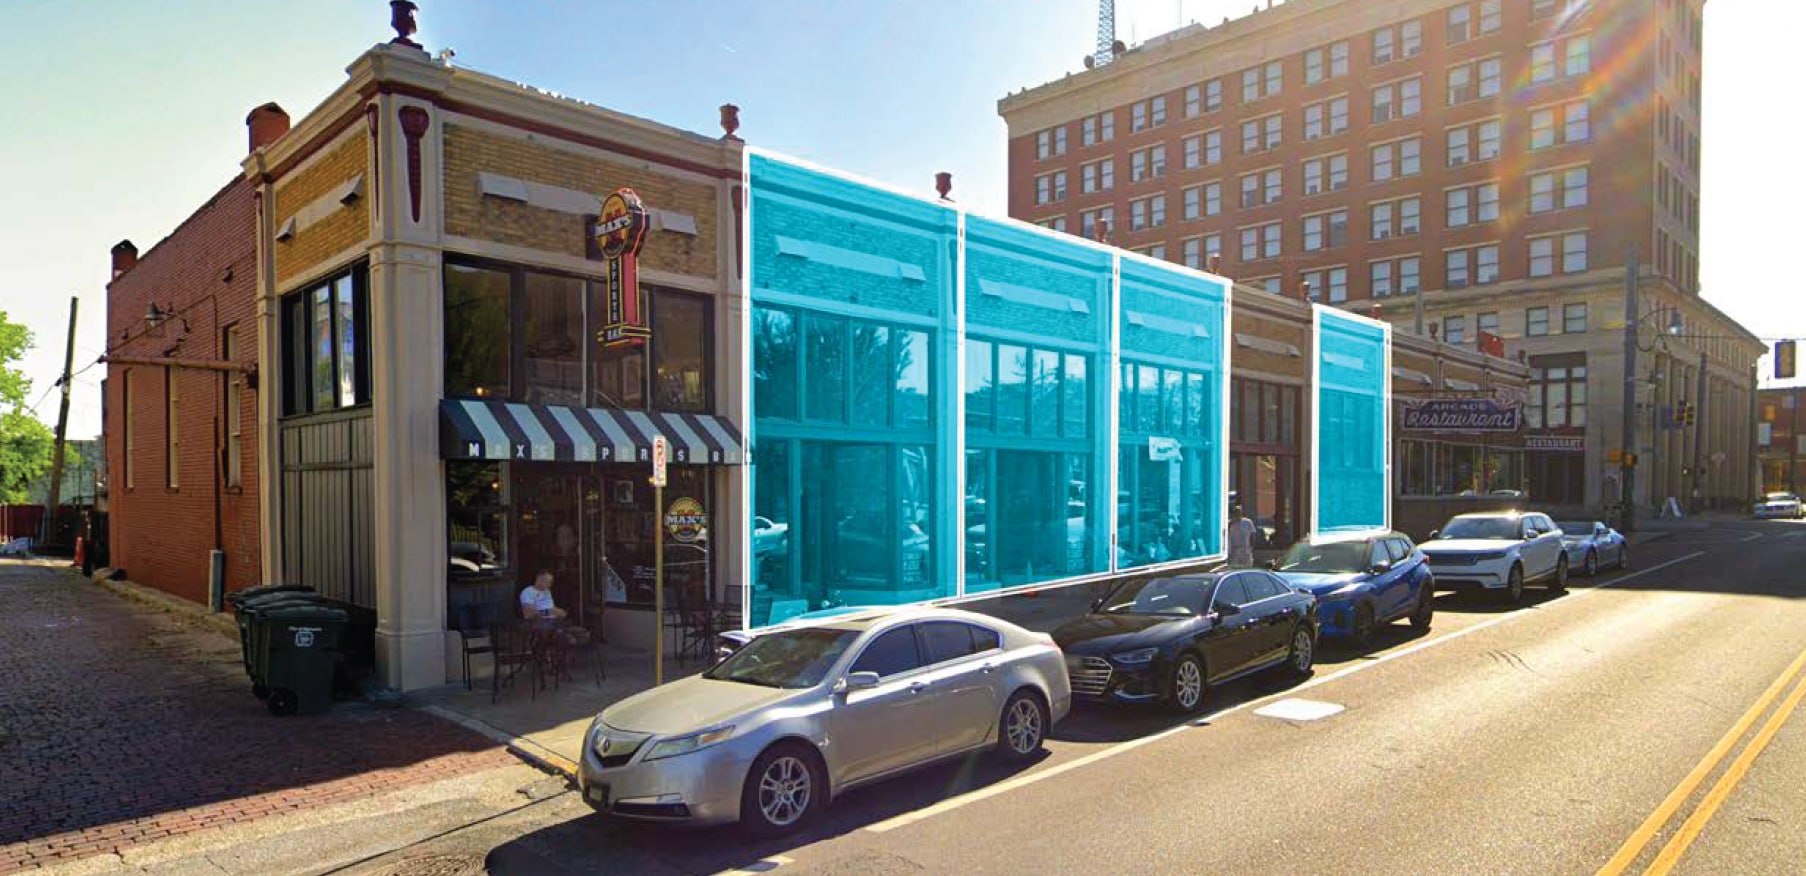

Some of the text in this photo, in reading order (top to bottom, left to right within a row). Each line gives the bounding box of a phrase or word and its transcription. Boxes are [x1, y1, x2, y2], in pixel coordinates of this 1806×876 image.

[1431, 401, 1488, 411] ARCADE
[1405, 411, 1513, 428] Restaurant
[1527, 438, 1582, 448] RESTAURANT
[581, 447, 685, 462] SPORS
